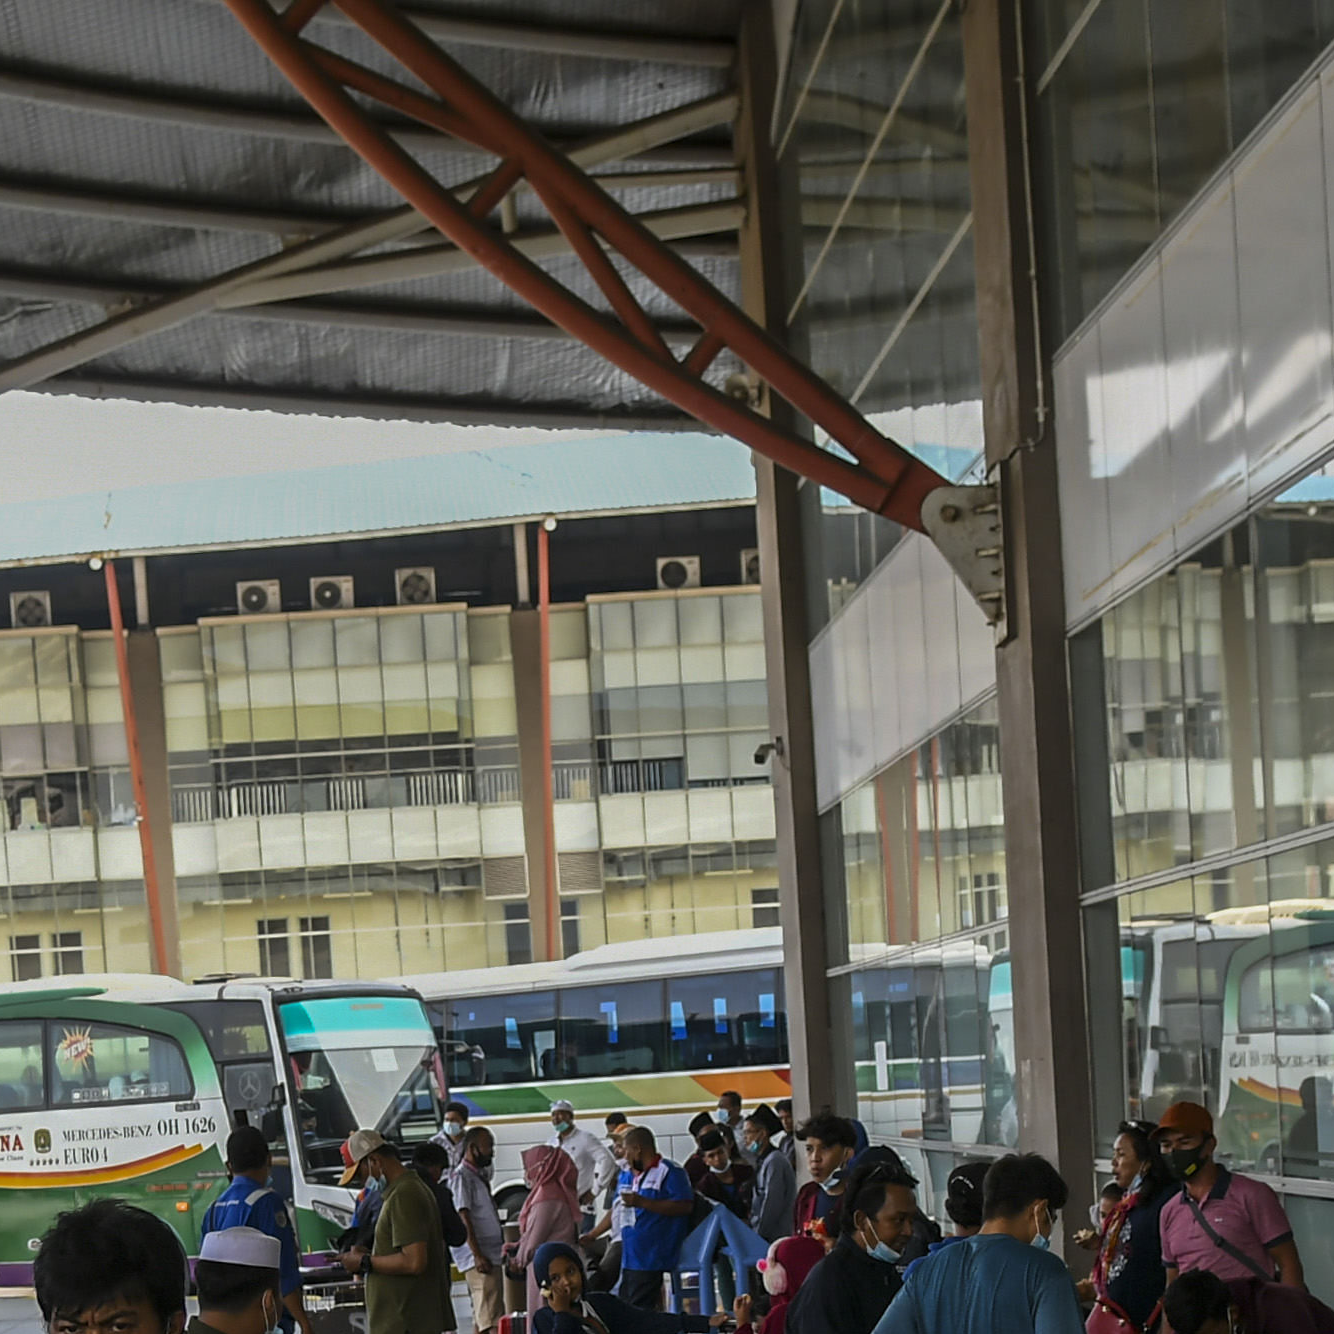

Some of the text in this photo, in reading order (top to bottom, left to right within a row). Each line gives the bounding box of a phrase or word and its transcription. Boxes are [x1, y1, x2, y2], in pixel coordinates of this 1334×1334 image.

[63, 1116, 216, 1142] MERCEDES-BENZ OH 1626
[64, 1148, 99, 1165] EURO
